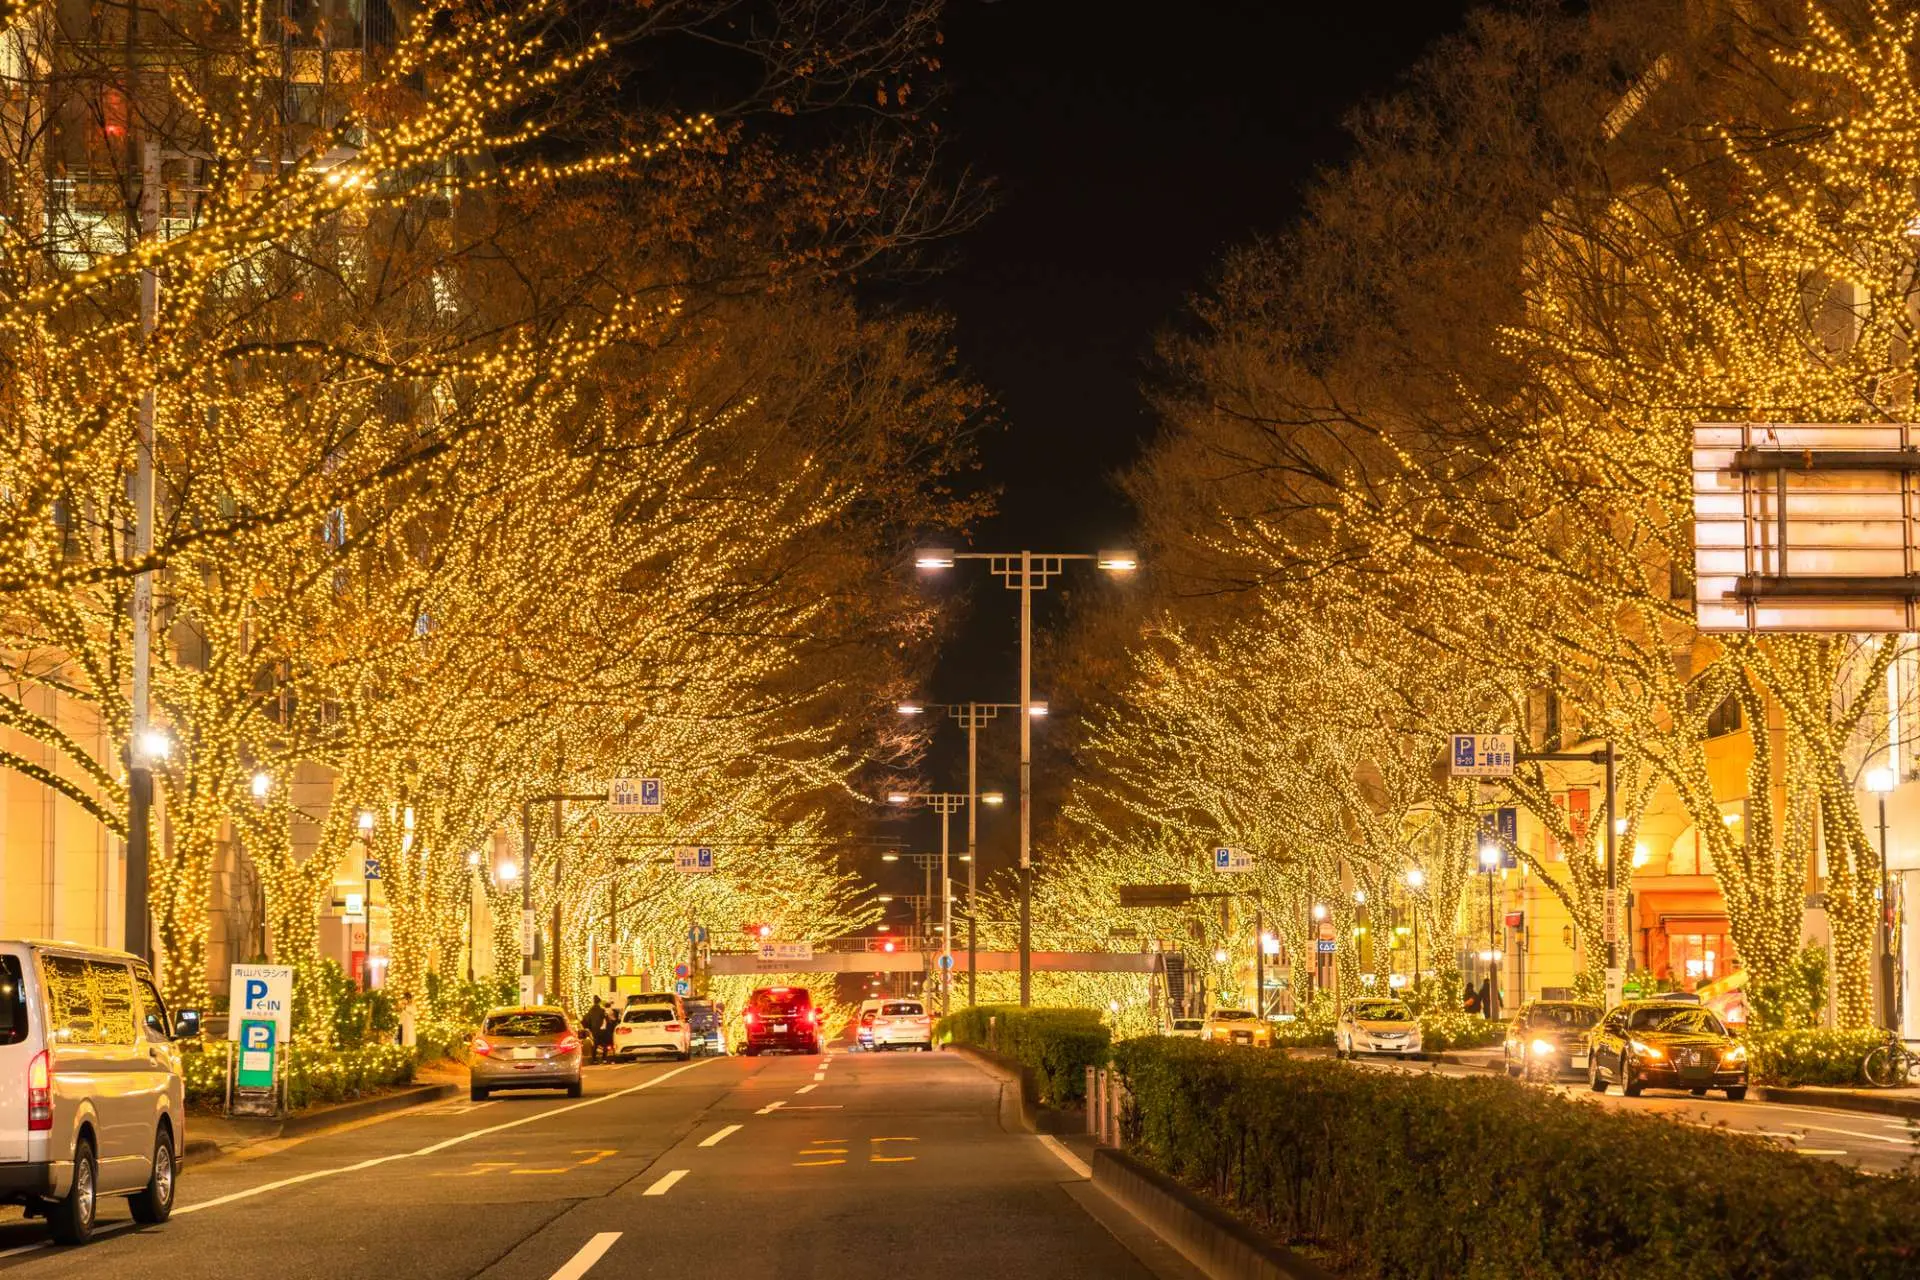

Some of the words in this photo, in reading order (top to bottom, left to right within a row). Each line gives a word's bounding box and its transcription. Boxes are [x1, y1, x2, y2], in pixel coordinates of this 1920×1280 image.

[1460, 739, 1472, 755] P
[646, 782, 656, 796] P
[701, 850, 709, 860] P
[1220, 850, 1227, 860] P
[245, 979, 268, 1010] P
[267, 1000, 280, 1010] IN
[248, 1027, 270, 1048] P
